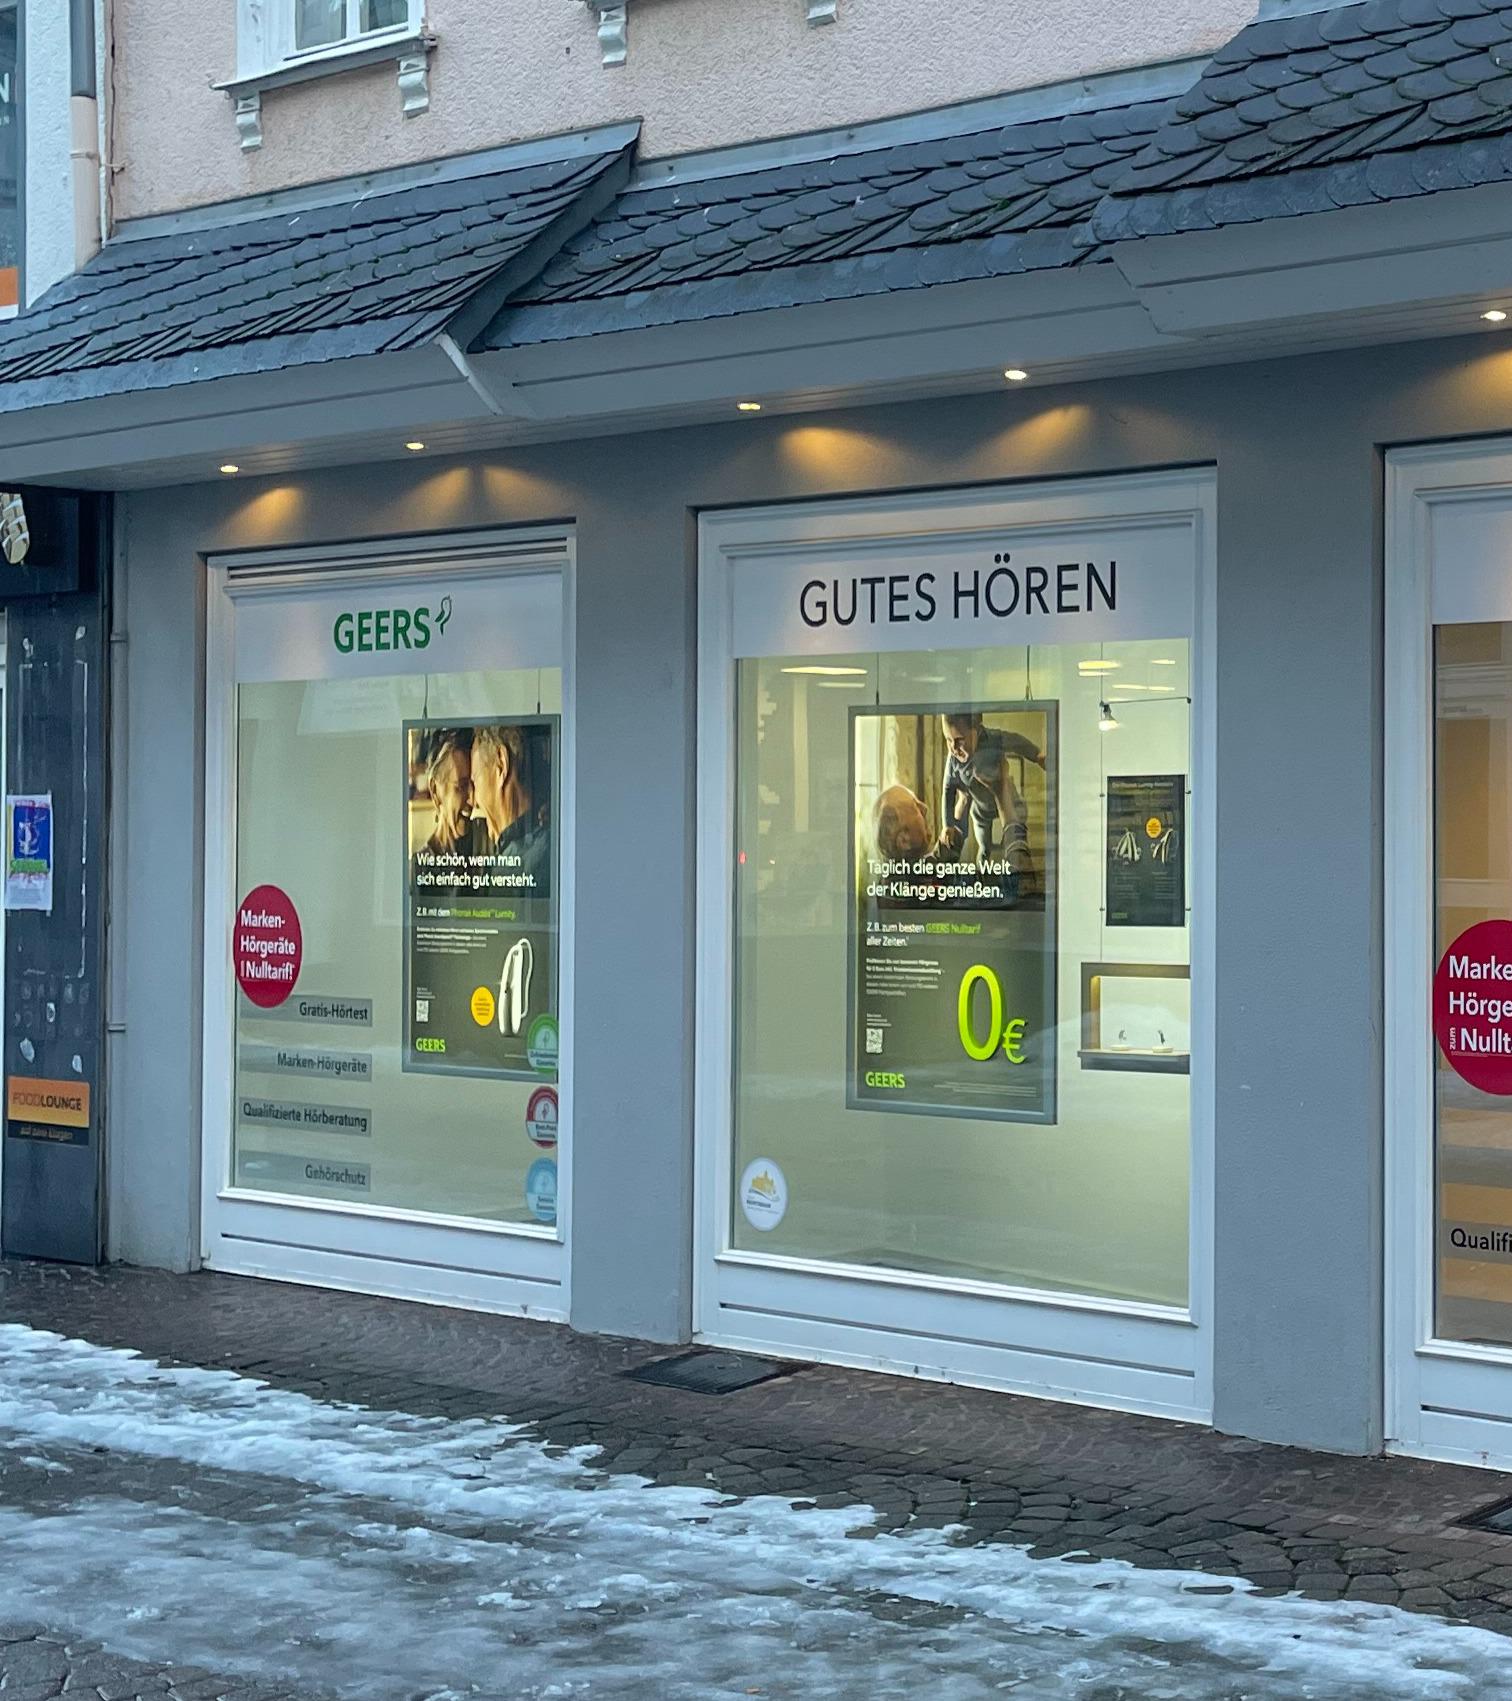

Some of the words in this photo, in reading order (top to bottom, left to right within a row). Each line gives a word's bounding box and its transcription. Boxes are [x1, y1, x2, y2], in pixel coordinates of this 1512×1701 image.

[800, 572, 936, 628] GUTES
[953, 553, 1117, 619] HÖREN
[333, 607, 431, 653] GEERS
[416, 853, 434, 866] Wie
[436, 852, 467, 868] schön,
[468, 855, 496, 867] wenn
[497, 855, 521, 867] man
[914, 859, 934, 875] die
[936, 861, 976, 878] ganze
[979, 860, 1011, 876] Welt
[416, 872, 435, 886] sich
[437, 872, 471, 886] einfach
[472, 874, 490, 890] gut
[491, 873, 537, 887] versteht.
[867, 882, 889, 897] der
[890, 881, 935, 901] Klänge
[938, 882, 1004, 901] genießen.
[241, 909, 285, 928] Marken-
[882, 923, 897, 932] zum
[899, 922, 925, 933] besten
[240, 934, 295, 958] Hörgeräte
[866, 936, 881, 946] aller
[299, 1001, 368, 1021] Gratis-Hörtest
[416, 1038, 445, 1053] GEERS
[277, 1052, 367, 1075] Marken-Hörgeräte
[865, 1071, 906, 1089] GEERS
[243, 1103, 301, 1122] Qualifizierte
[304, 1108, 367, 1132] Hörberatung
[305, 1163, 366, 1185] Gehörschutz
